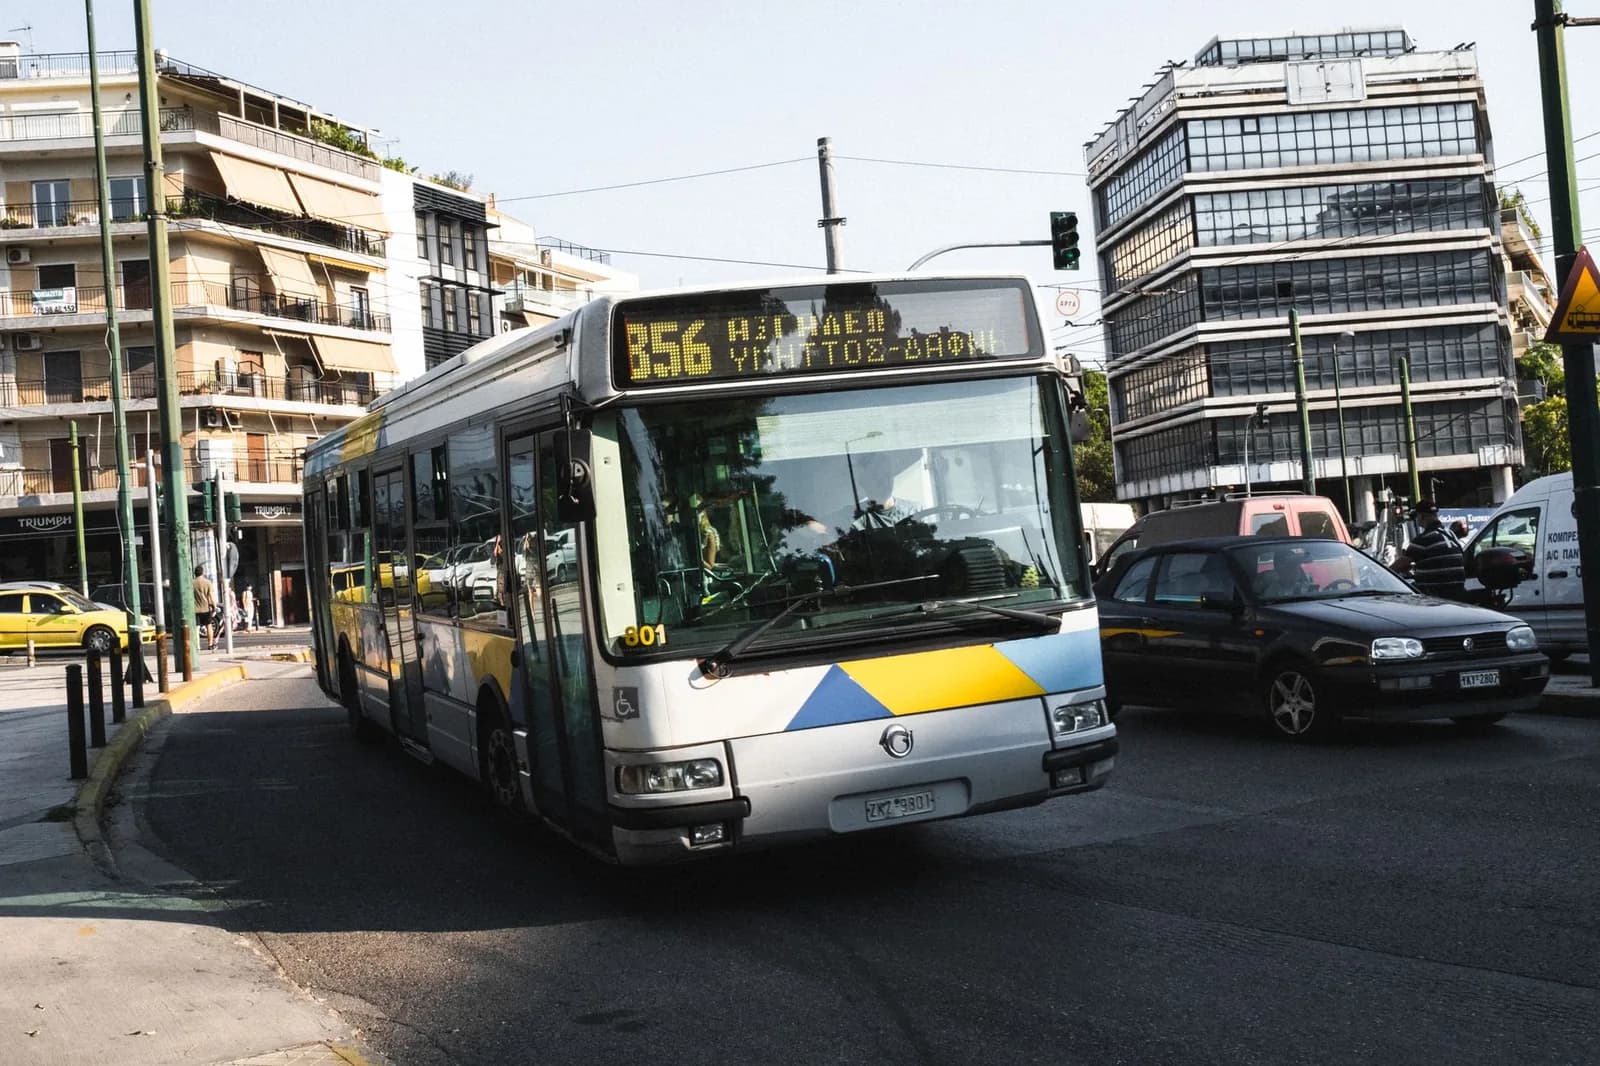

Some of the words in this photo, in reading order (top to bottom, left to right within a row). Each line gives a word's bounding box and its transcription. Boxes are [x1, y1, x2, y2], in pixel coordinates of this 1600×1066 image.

[254, 505, 286, 518] TRIUMPH
[17, 515, 72, 530] TRIUMPH
[1548, 531, 1577, 543] ΚΟΜΠΡΕ
[624, 624, 666, 647] 801
